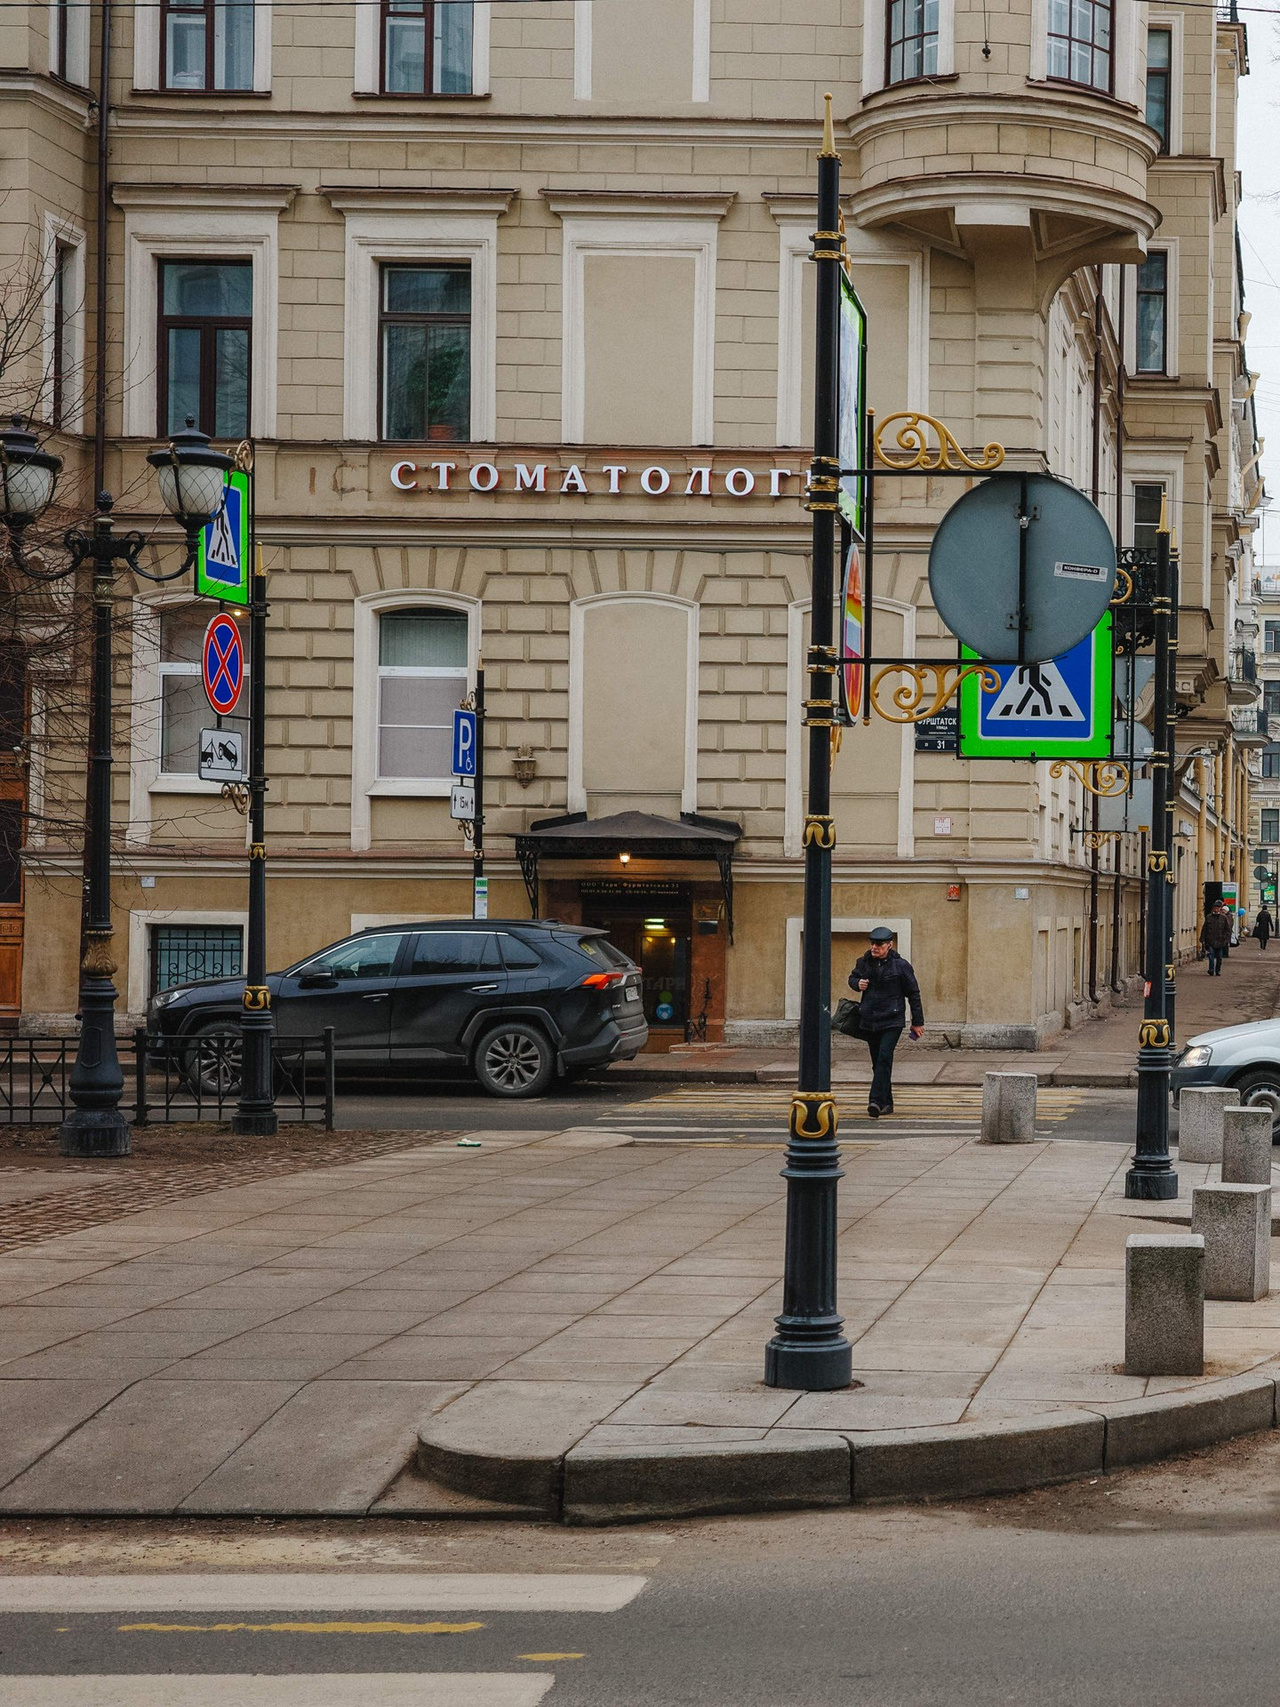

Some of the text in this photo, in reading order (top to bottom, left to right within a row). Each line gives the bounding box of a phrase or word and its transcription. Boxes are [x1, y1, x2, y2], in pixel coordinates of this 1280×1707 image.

[390, 461, 810, 497] СТОМАТОЛОГ
[917, 717, 958, 726] ФУРШТАТСК
[936, 740, 946, 749] 31
